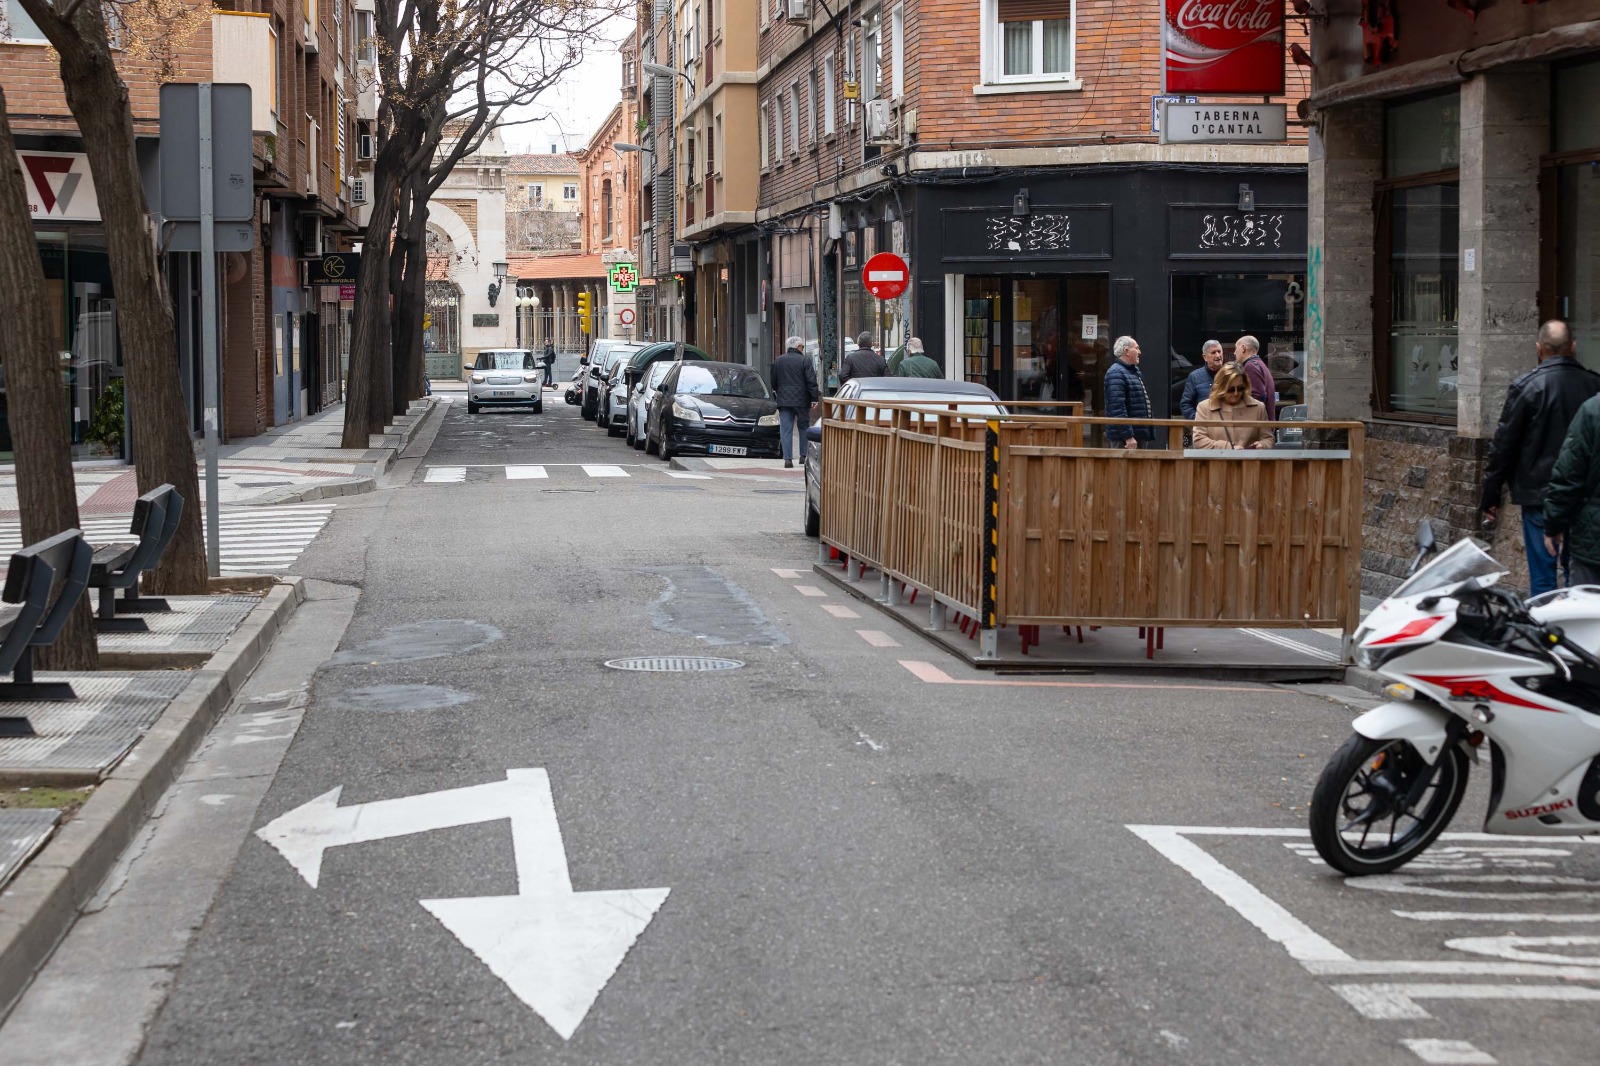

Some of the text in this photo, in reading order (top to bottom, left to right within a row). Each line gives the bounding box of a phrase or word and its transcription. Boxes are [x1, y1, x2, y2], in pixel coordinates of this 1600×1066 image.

[1177, 0, 1275, 30] Coca-Cola
[1194, 110, 1260, 121] TABERNA
[1191, 124, 1263, 134] O'CANTAL
[613, 273, 635, 282] PRES
[1505, 799, 1574, 819] SUZUKI
